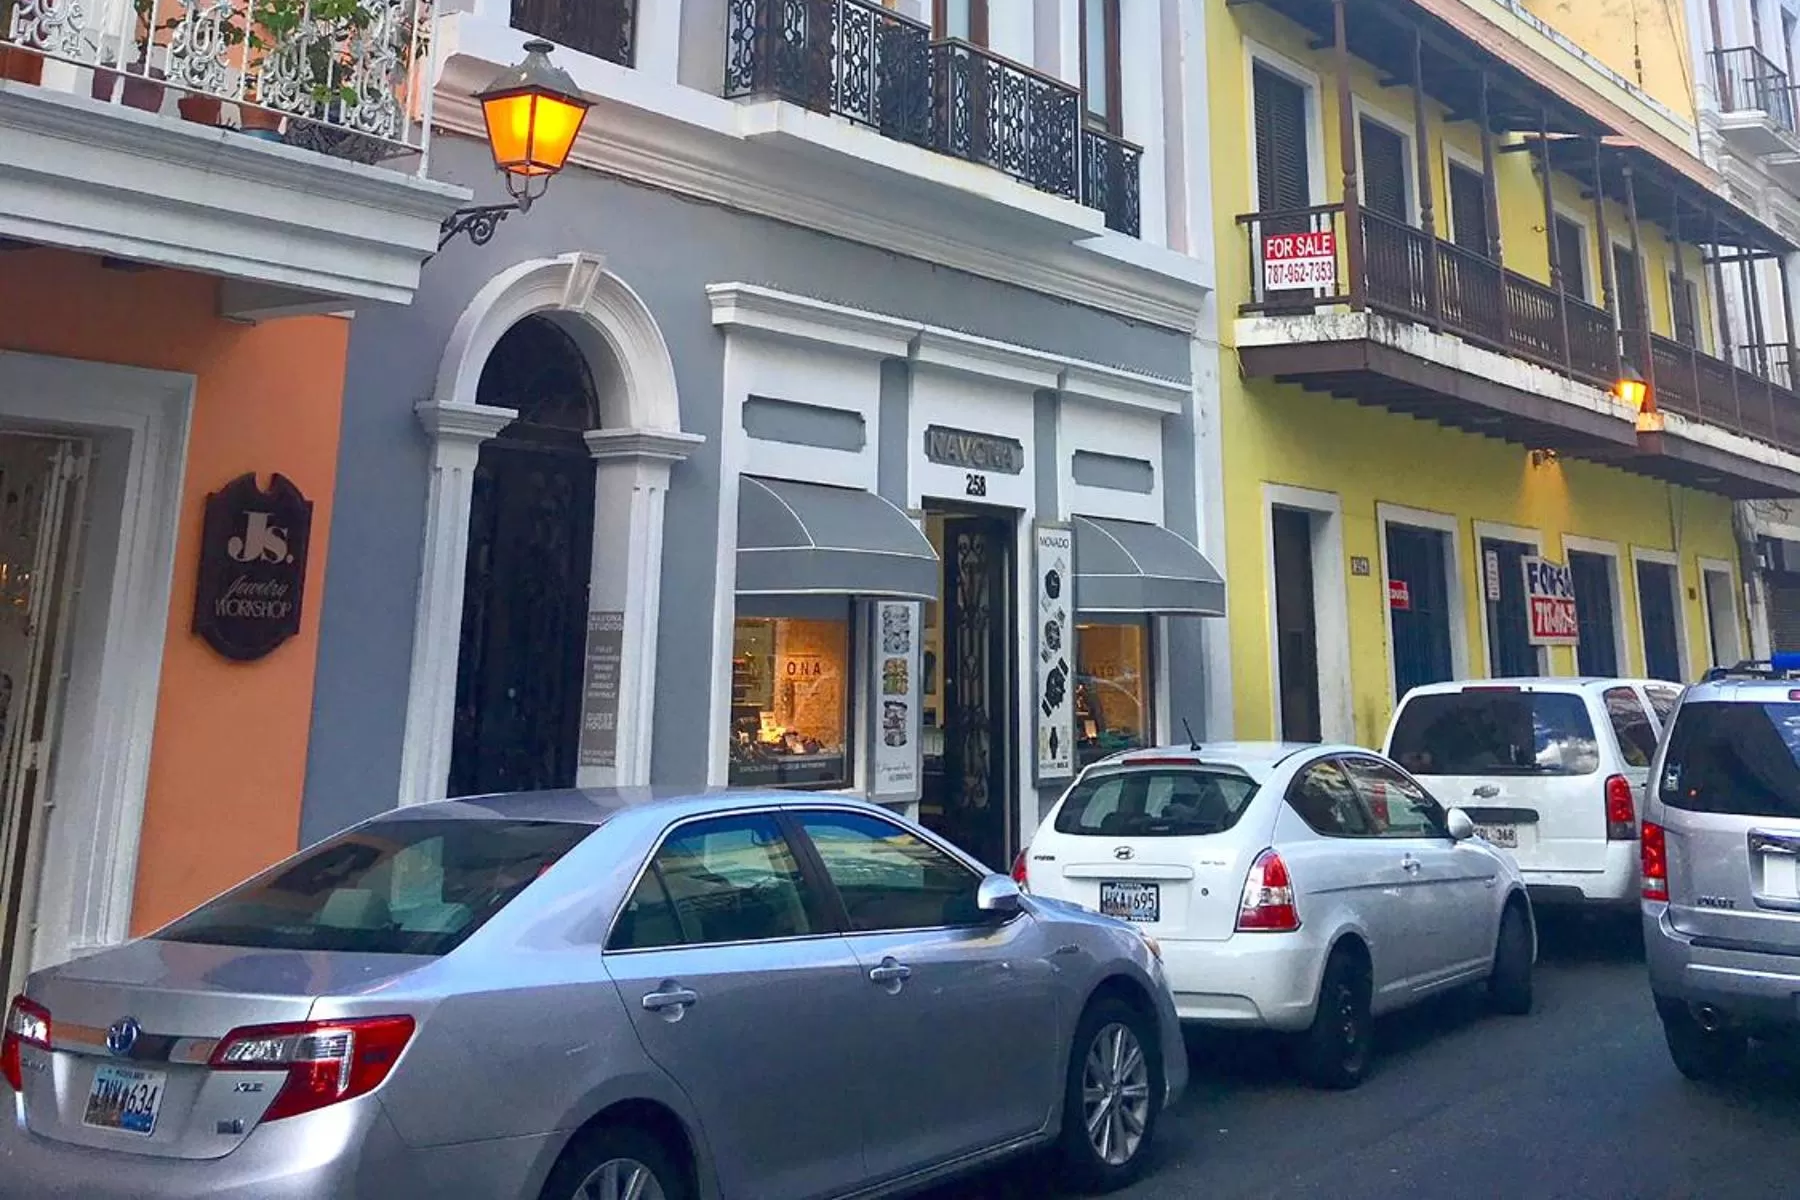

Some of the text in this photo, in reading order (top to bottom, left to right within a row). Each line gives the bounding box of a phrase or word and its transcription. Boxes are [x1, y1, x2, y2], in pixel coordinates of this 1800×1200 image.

[1266, 234, 1331, 258] FOR SALE
[1267, 261, 1333, 284] 787-962-7353
[966, 474, 986, 496] 258
[215, 599, 292, 619] WORKSHOP
[1134, 892, 1155, 910] 695
[126, 1083, 158, 1116] 634
